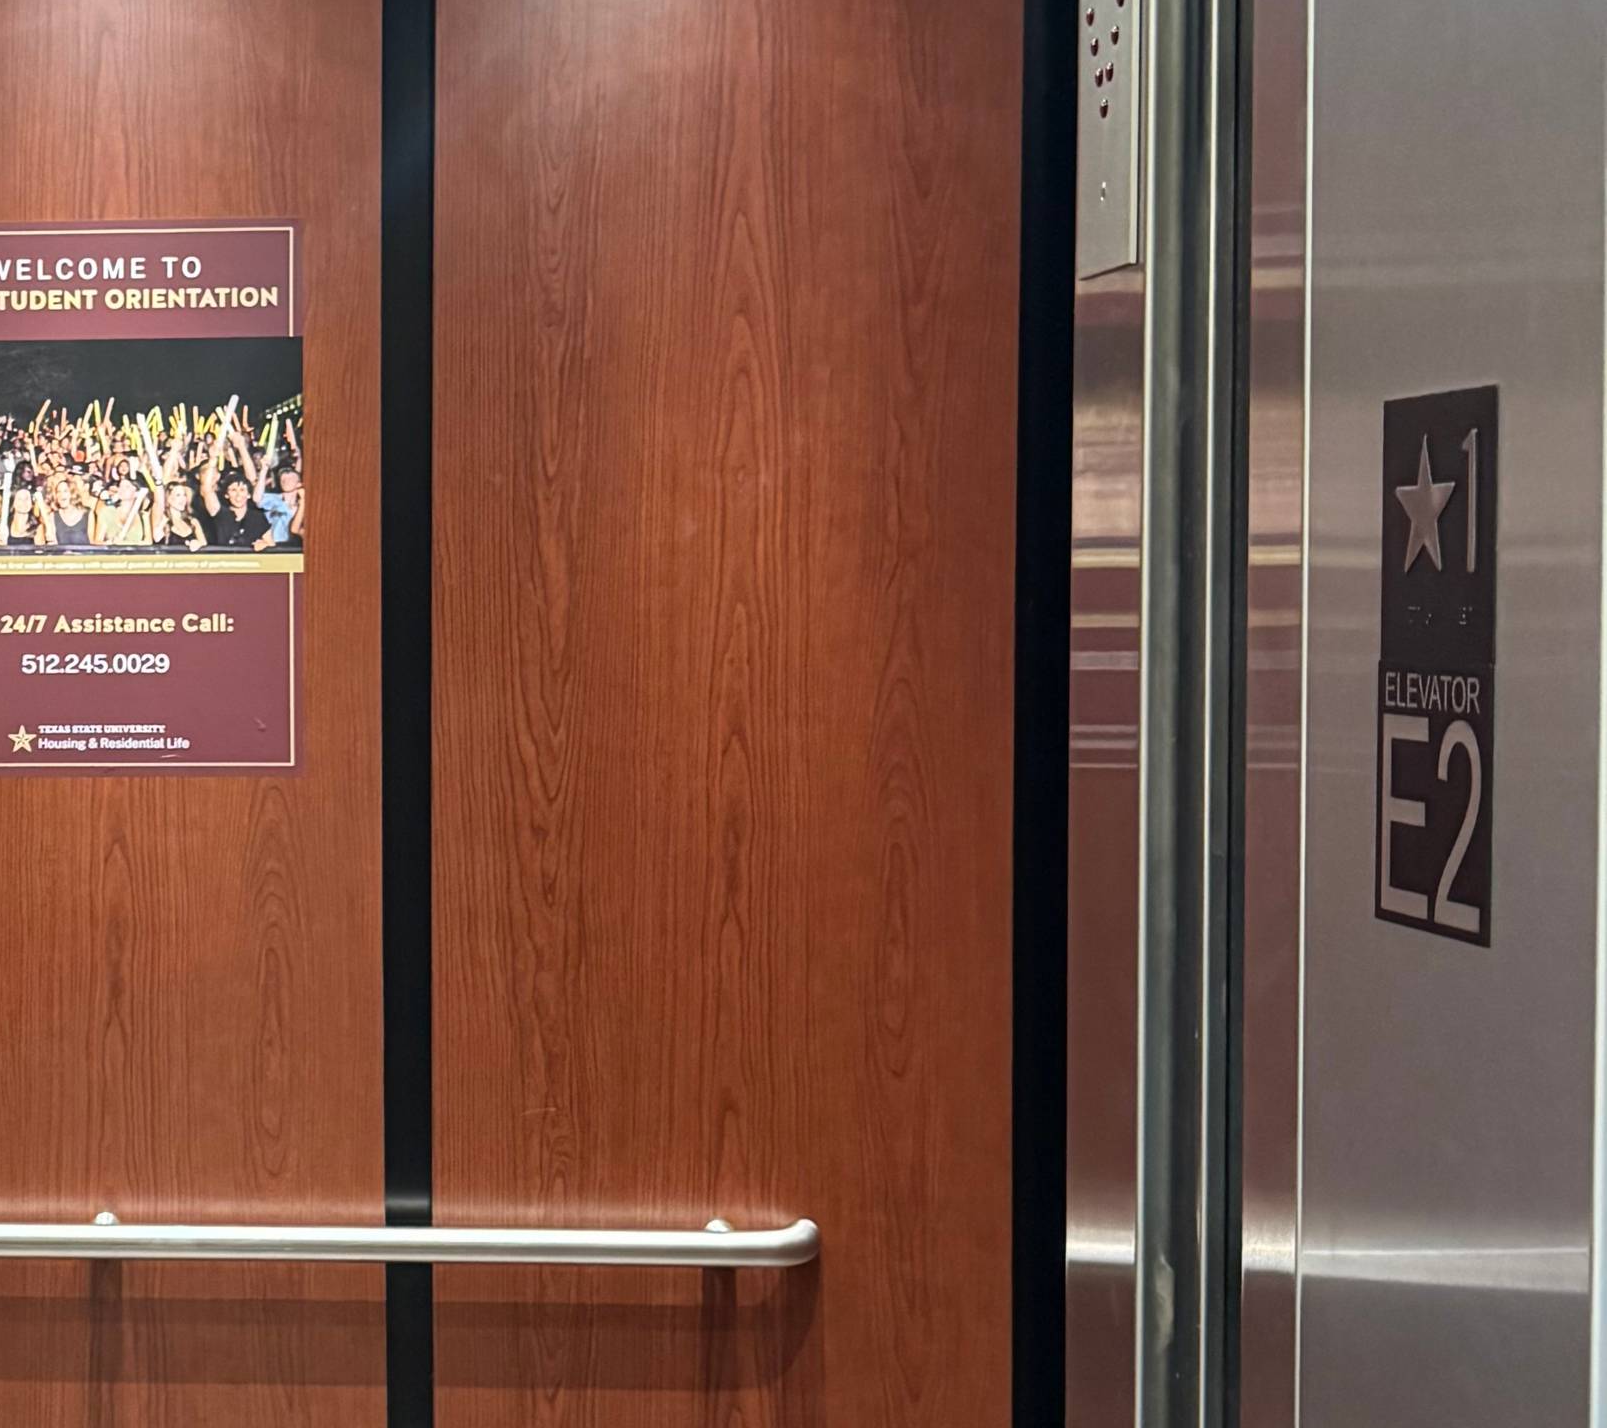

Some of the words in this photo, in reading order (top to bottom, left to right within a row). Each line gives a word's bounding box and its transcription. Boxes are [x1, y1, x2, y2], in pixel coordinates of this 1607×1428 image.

[161, 256, 202, 279] TO
[104, 286, 279, 309] ORIENTATION
[1461, 427, 1479, 573] 1
[0, 614, 48, 634] 24/7
[53, 614, 175, 634] Assistance
[181, 612, 235, 633] Call:
[21, 653, 171, 675] 512.245.0029
[1384, 671, 1481, 714] ELEVATOR
[37, 724, 70, 734] TEXAS
[71, 724, 103, 734] STATE
[103, 724, 166, 734] UNIVERSITY
[37, 737, 87, 751] Housing
[88, 738, 99, 750] &
[99, 737, 165, 750] Residential
[166, 737, 191, 750] Life
[1380, 713, 1482, 933] E2
